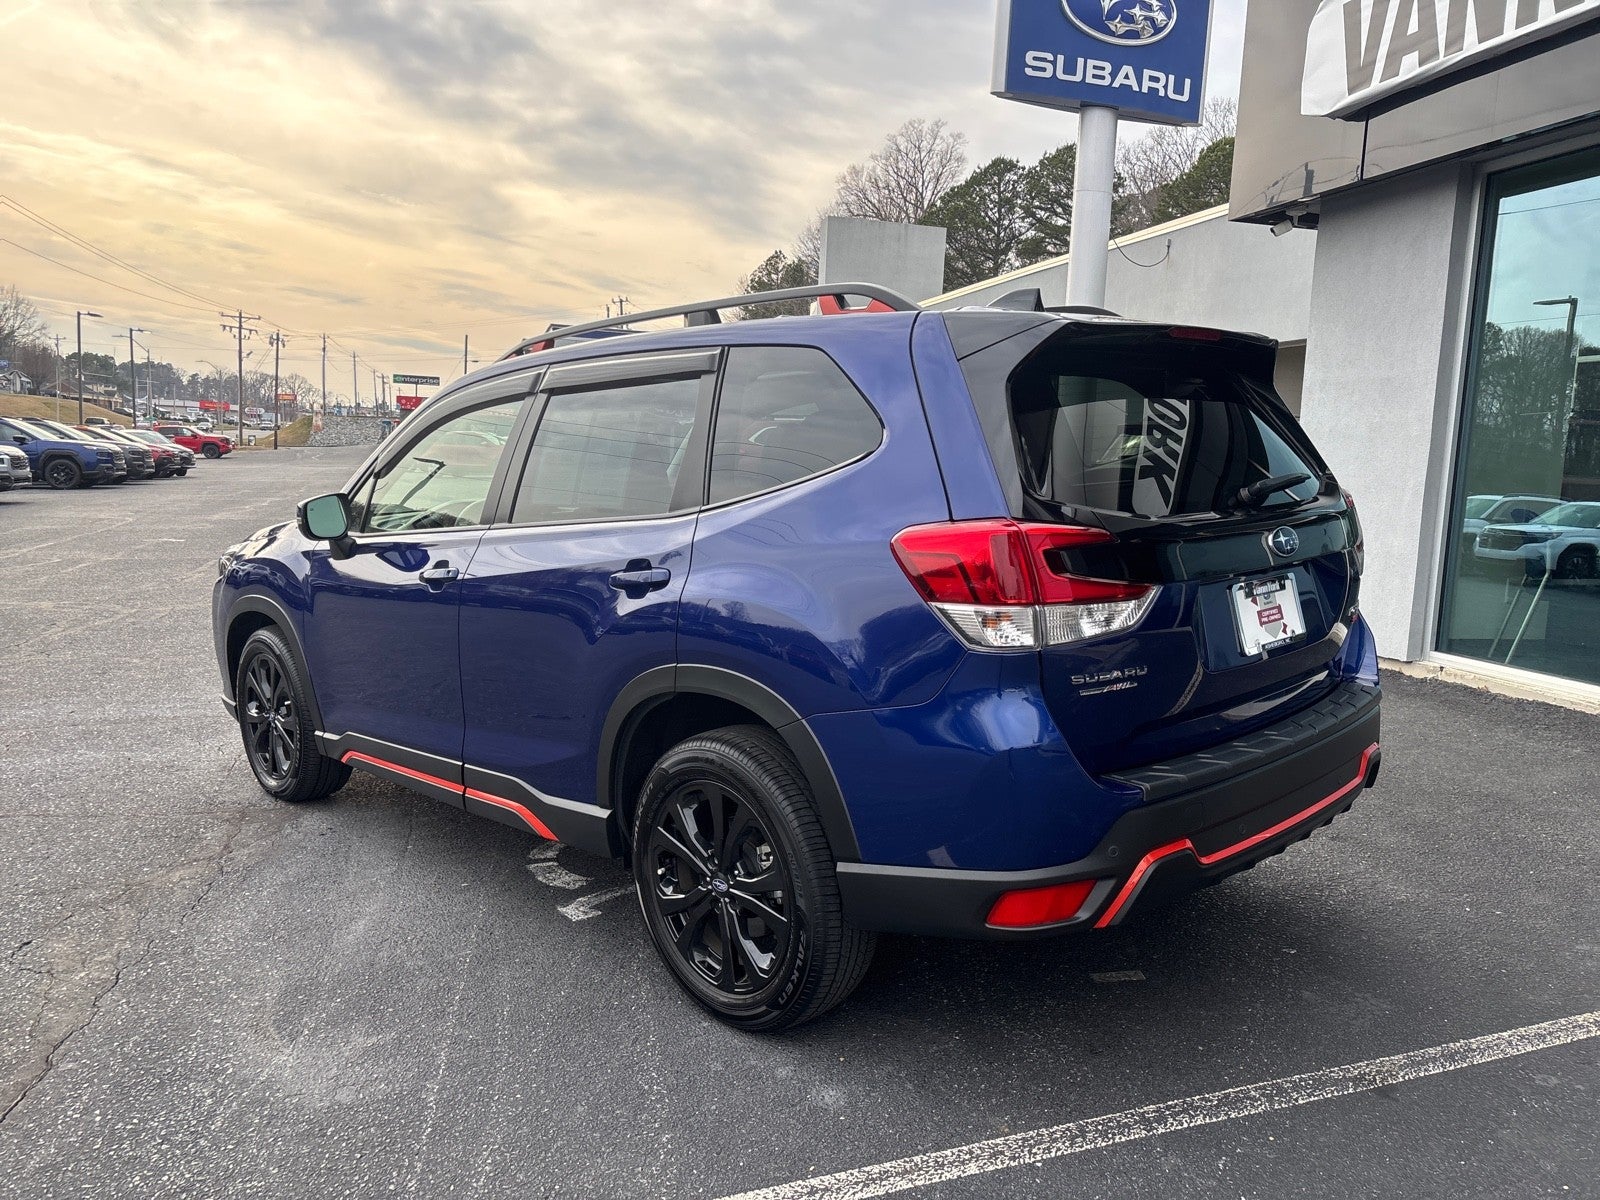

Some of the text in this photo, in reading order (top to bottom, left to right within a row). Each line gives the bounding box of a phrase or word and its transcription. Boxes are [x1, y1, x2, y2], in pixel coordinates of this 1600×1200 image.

[1024, 50, 1192, 102] SUBARU
[396, 375, 439, 384] enterprise
[1071, 665, 1148, 685] SUBARU
